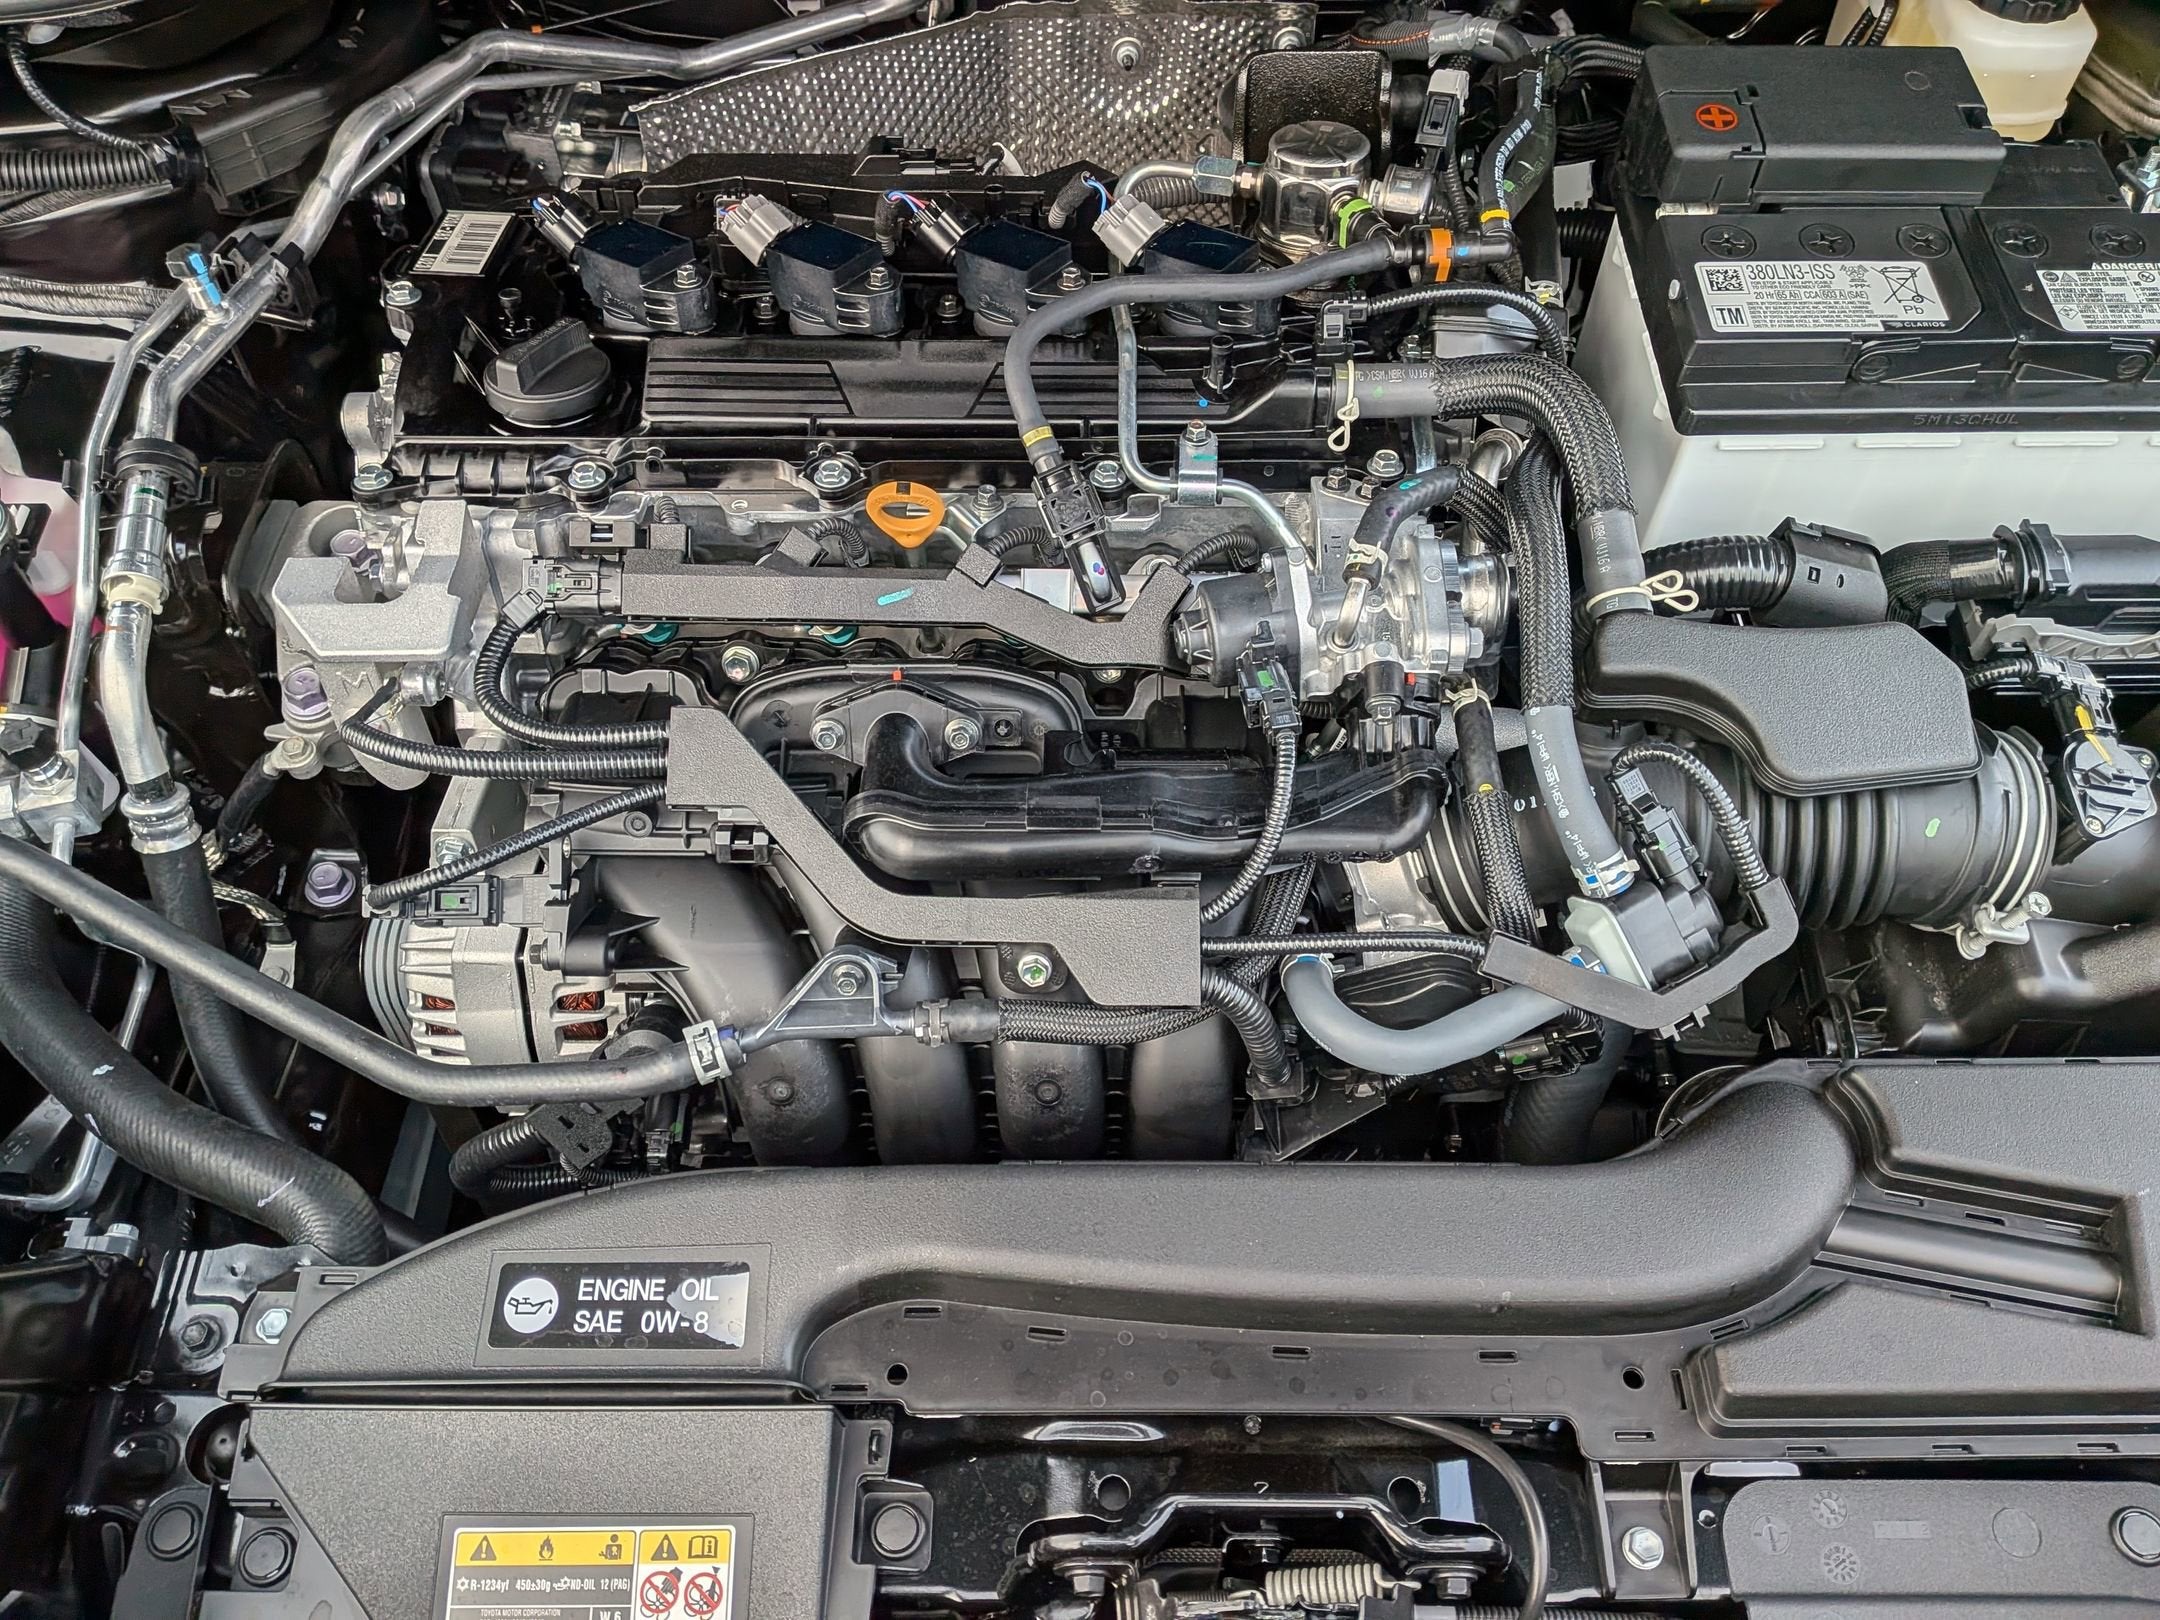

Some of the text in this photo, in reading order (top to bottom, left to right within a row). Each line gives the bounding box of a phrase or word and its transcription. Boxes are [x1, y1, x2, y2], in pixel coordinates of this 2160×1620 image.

[1746, 263, 1836, 280] 380LN3-ISS
[2101, 262, 2160, 270] DANGER/
[1754, 291, 1764, 299] 20
[1789, 290, 1800, 299] Ah
[1803, 291, 1820, 299] CCA
[1847, 290, 1868, 300] (SAE)
[1716, 307, 1744, 324] TM
[1903, 305, 1924, 314] Pb
[577, 1278, 719, 1301] ENGINE OIL
[573, 1311, 709, 1334] SAE 0W-8
[470, 1578, 631, 1593] R-1234yf 450±30g ND-OIL 12 (PAG)
